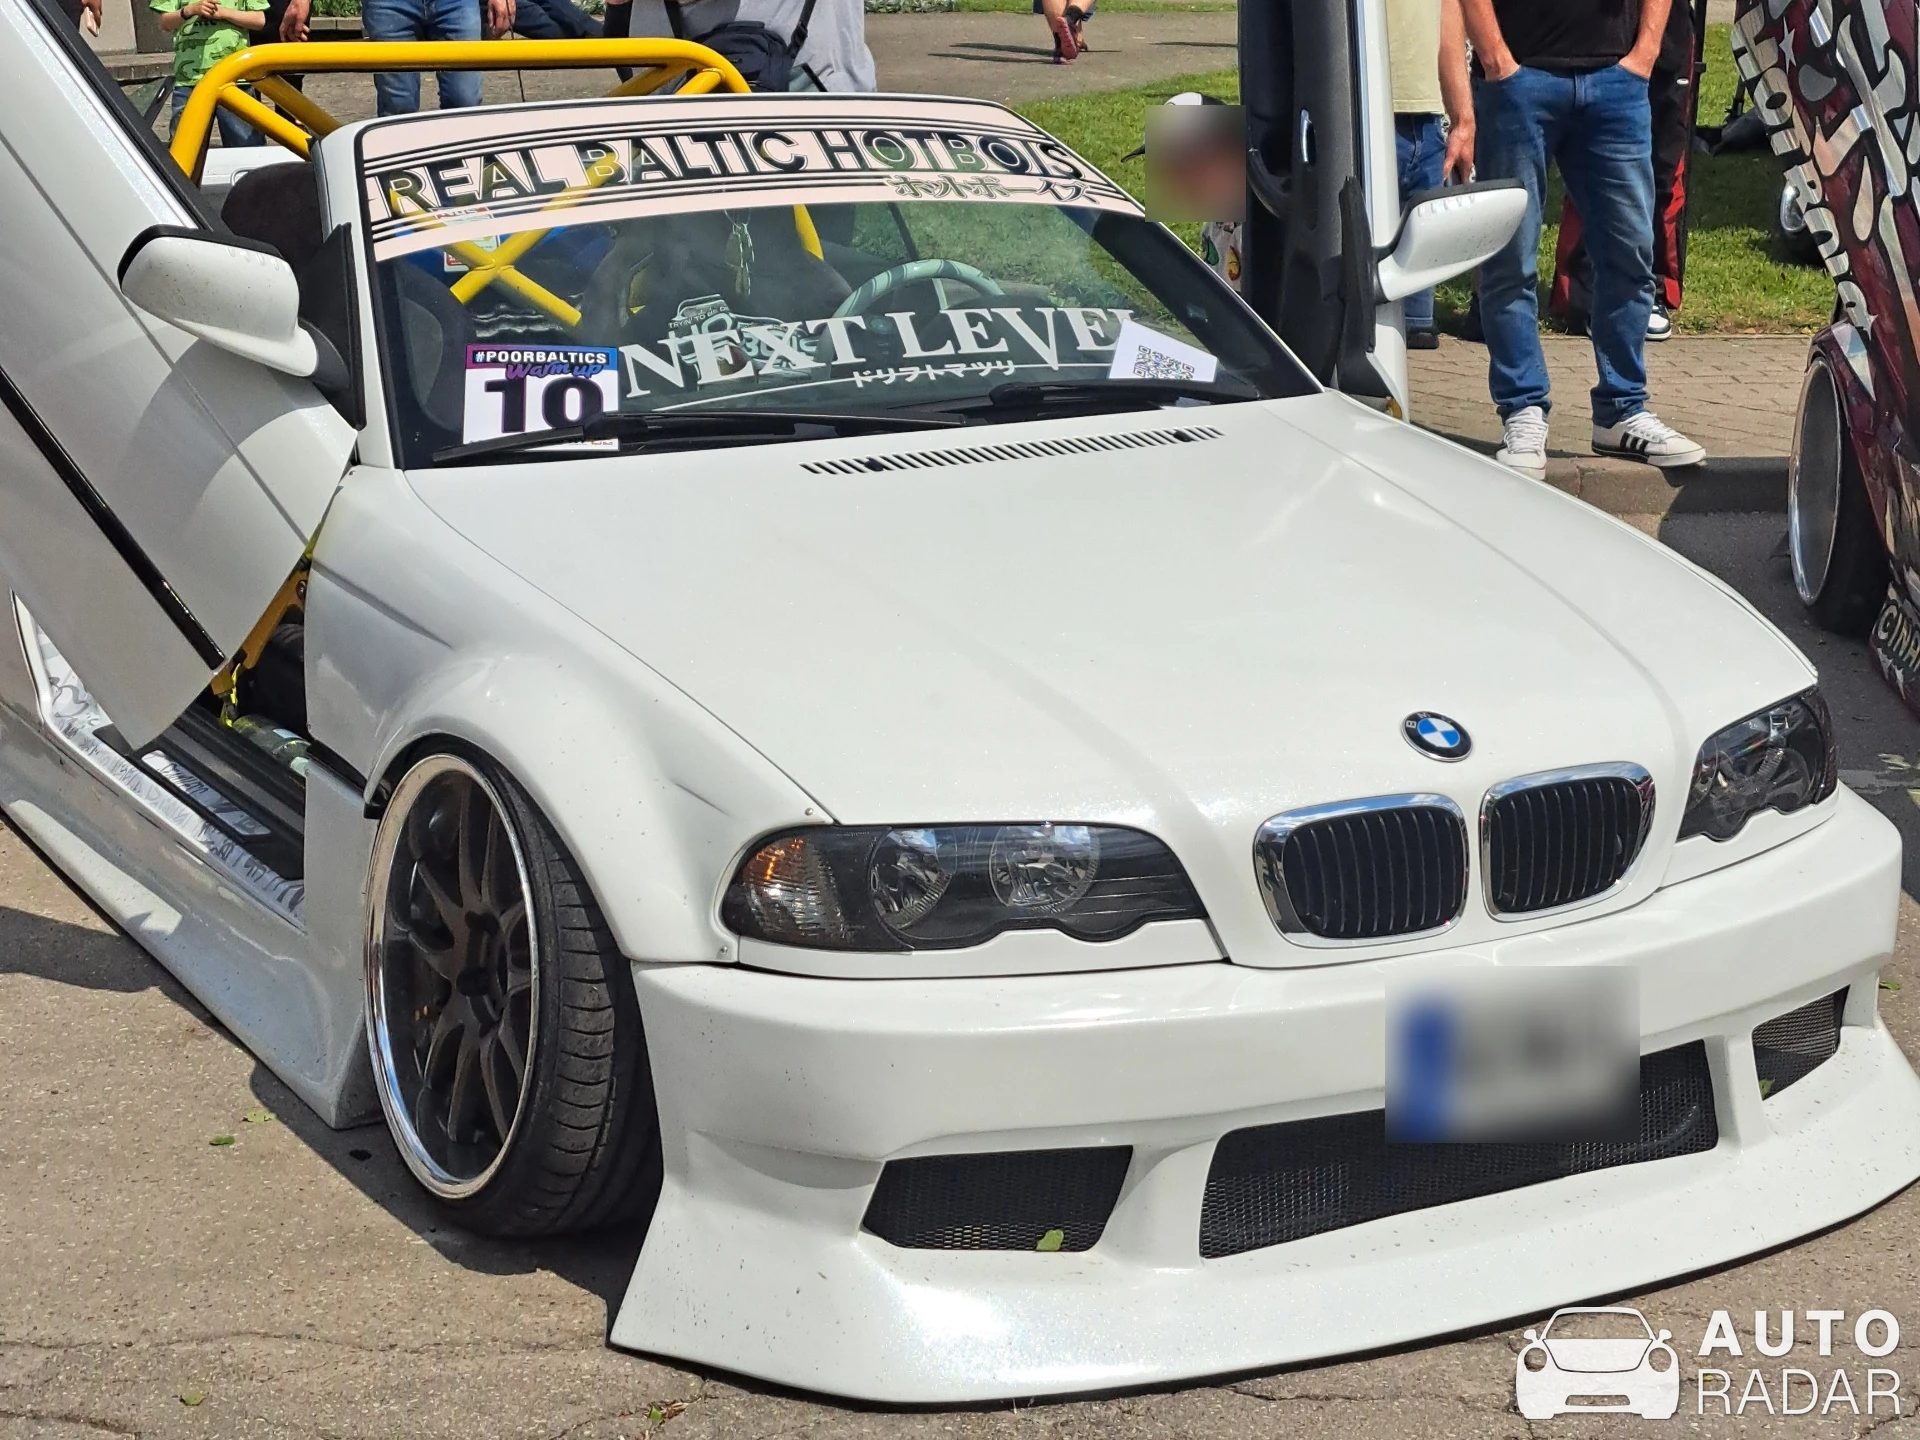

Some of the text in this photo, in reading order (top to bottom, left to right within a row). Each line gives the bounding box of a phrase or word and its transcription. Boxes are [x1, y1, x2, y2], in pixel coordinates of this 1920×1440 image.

[375, 130, 1085, 218] REAL BALTIC HOTBOIS
[475, 351, 607, 363] #POORBALTICS
[572, 364, 604, 380] up
[618, 315, 866, 399] NEXT
[852, 360, 1015, 388] ドリフトマツリ
[484, 376, 604, 433] 10
